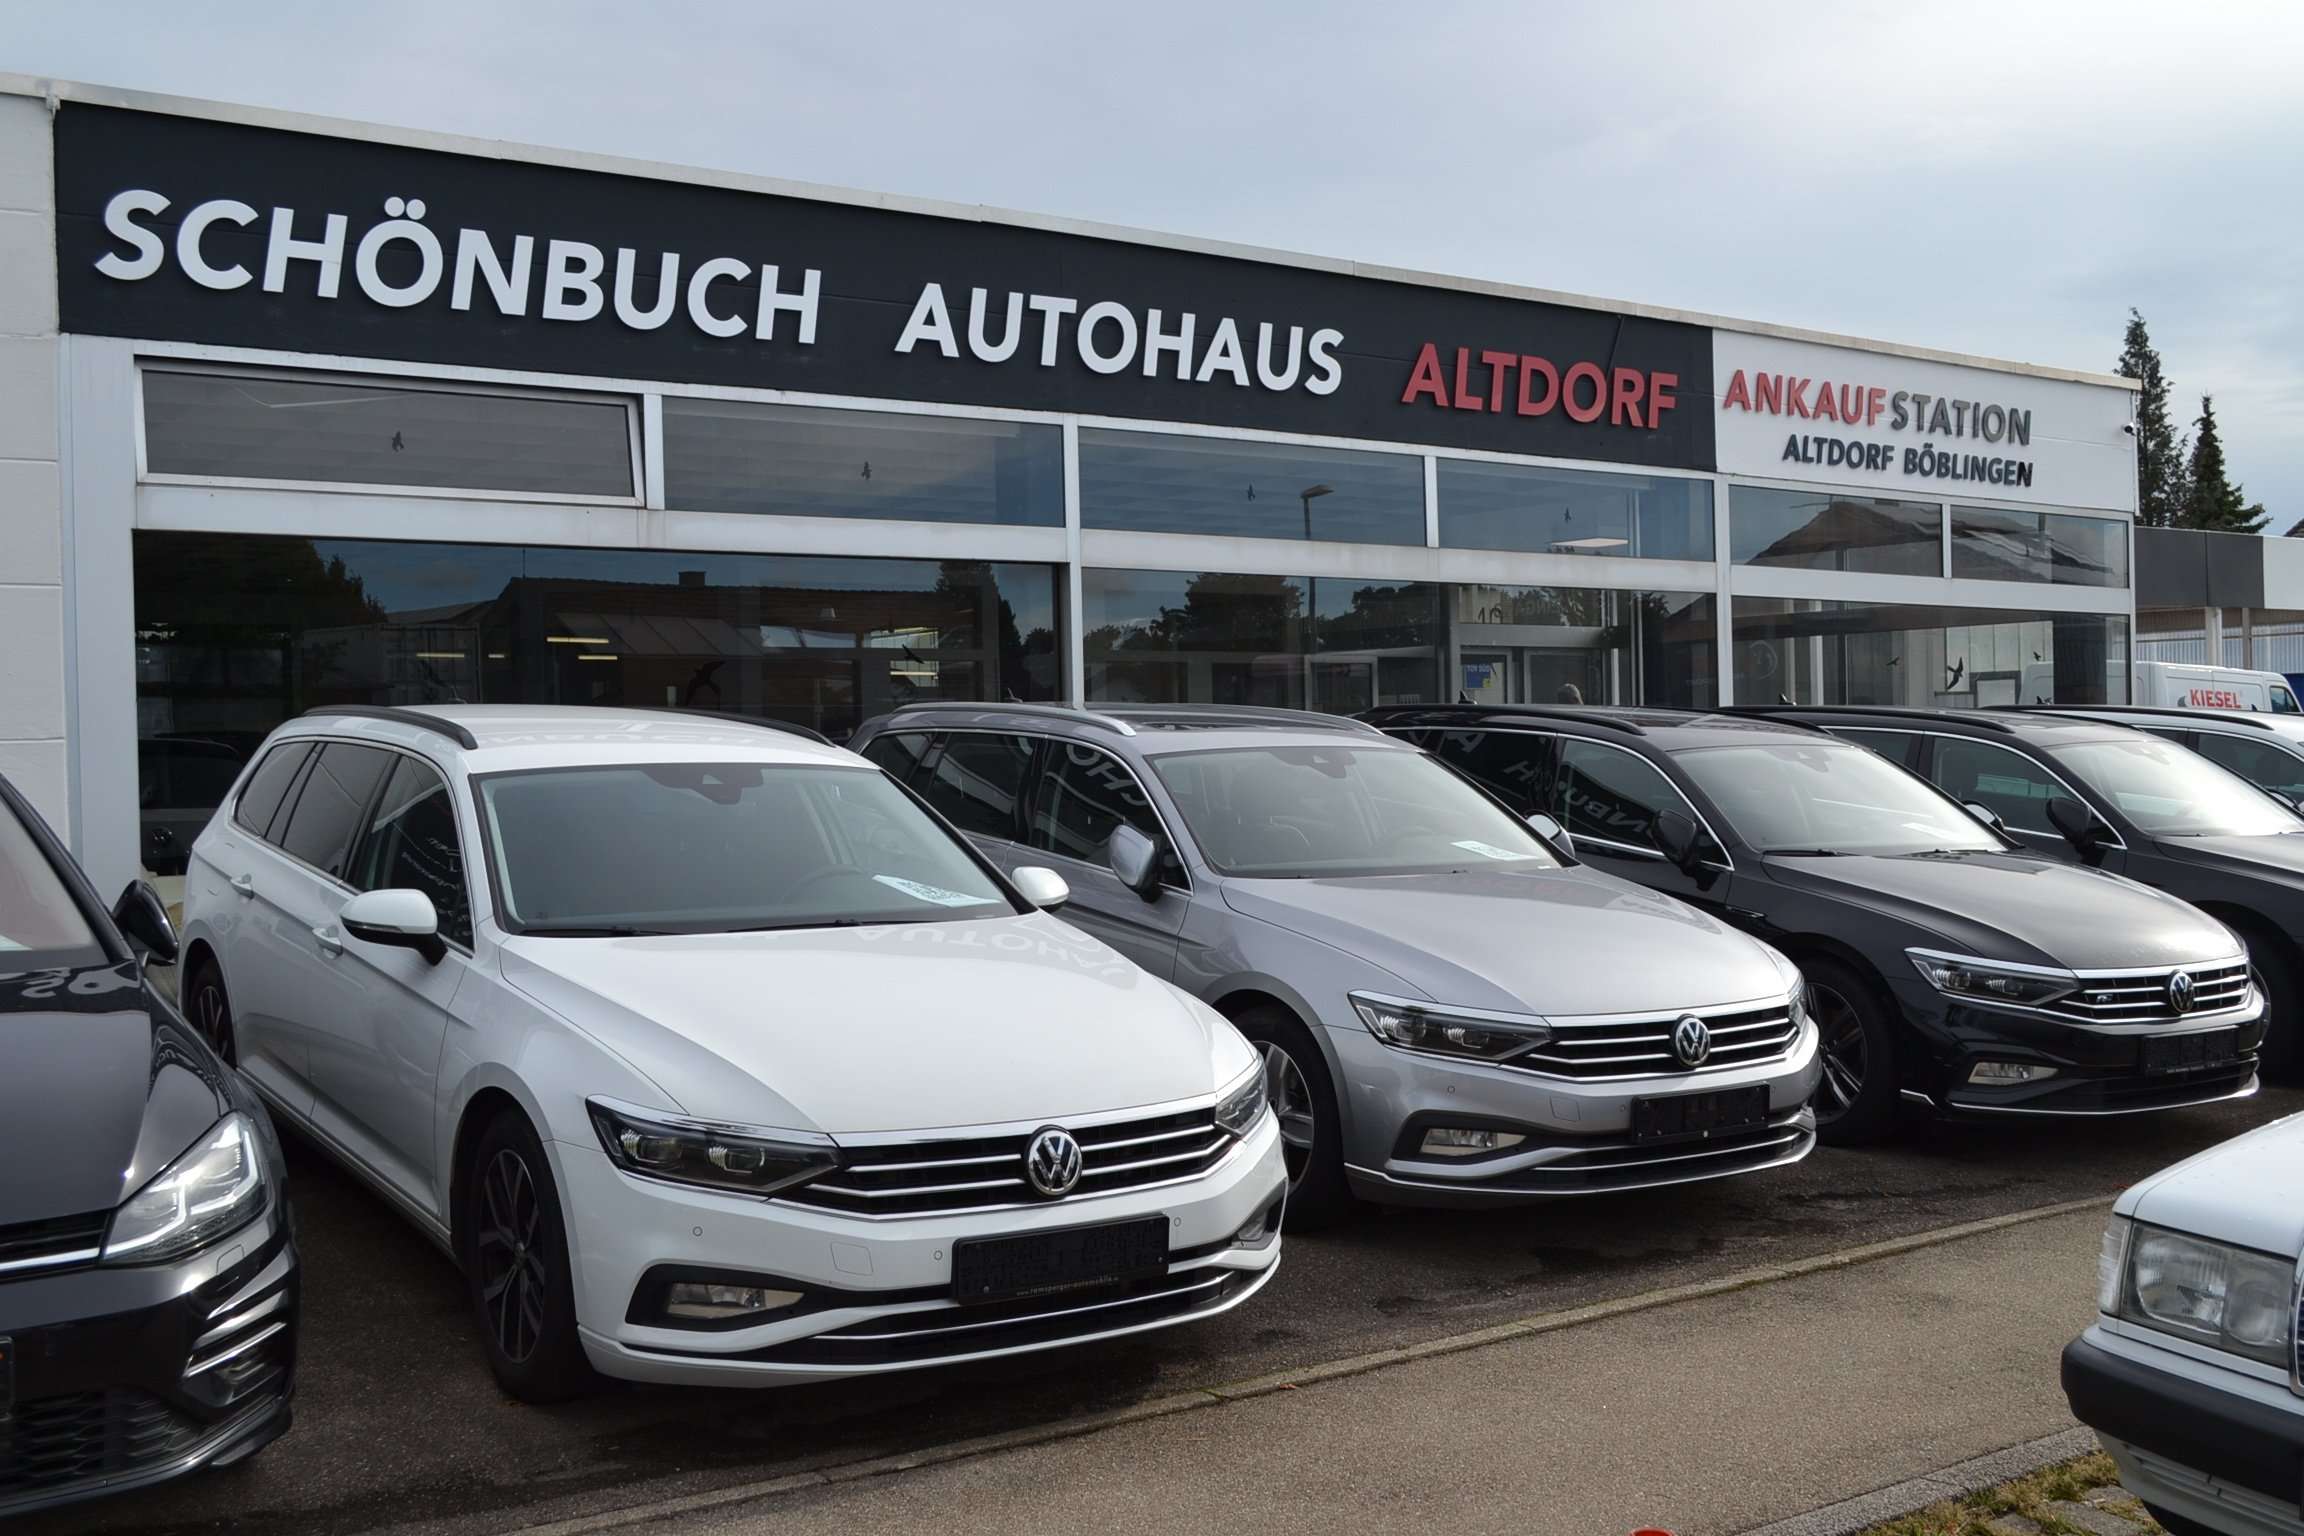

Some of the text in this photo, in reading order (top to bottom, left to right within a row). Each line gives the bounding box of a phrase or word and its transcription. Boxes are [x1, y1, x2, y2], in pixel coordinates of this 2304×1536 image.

[94, 189, 1679, 430] SCHÖNBUCH AUTOHAUS ALTDORF
[1782, 433, 2034, 487] ALTDORF BÖBLINGEN
[2190, 689, 2242, 708] KIESEL
[1029, 1128, 1082, 1196] VW
